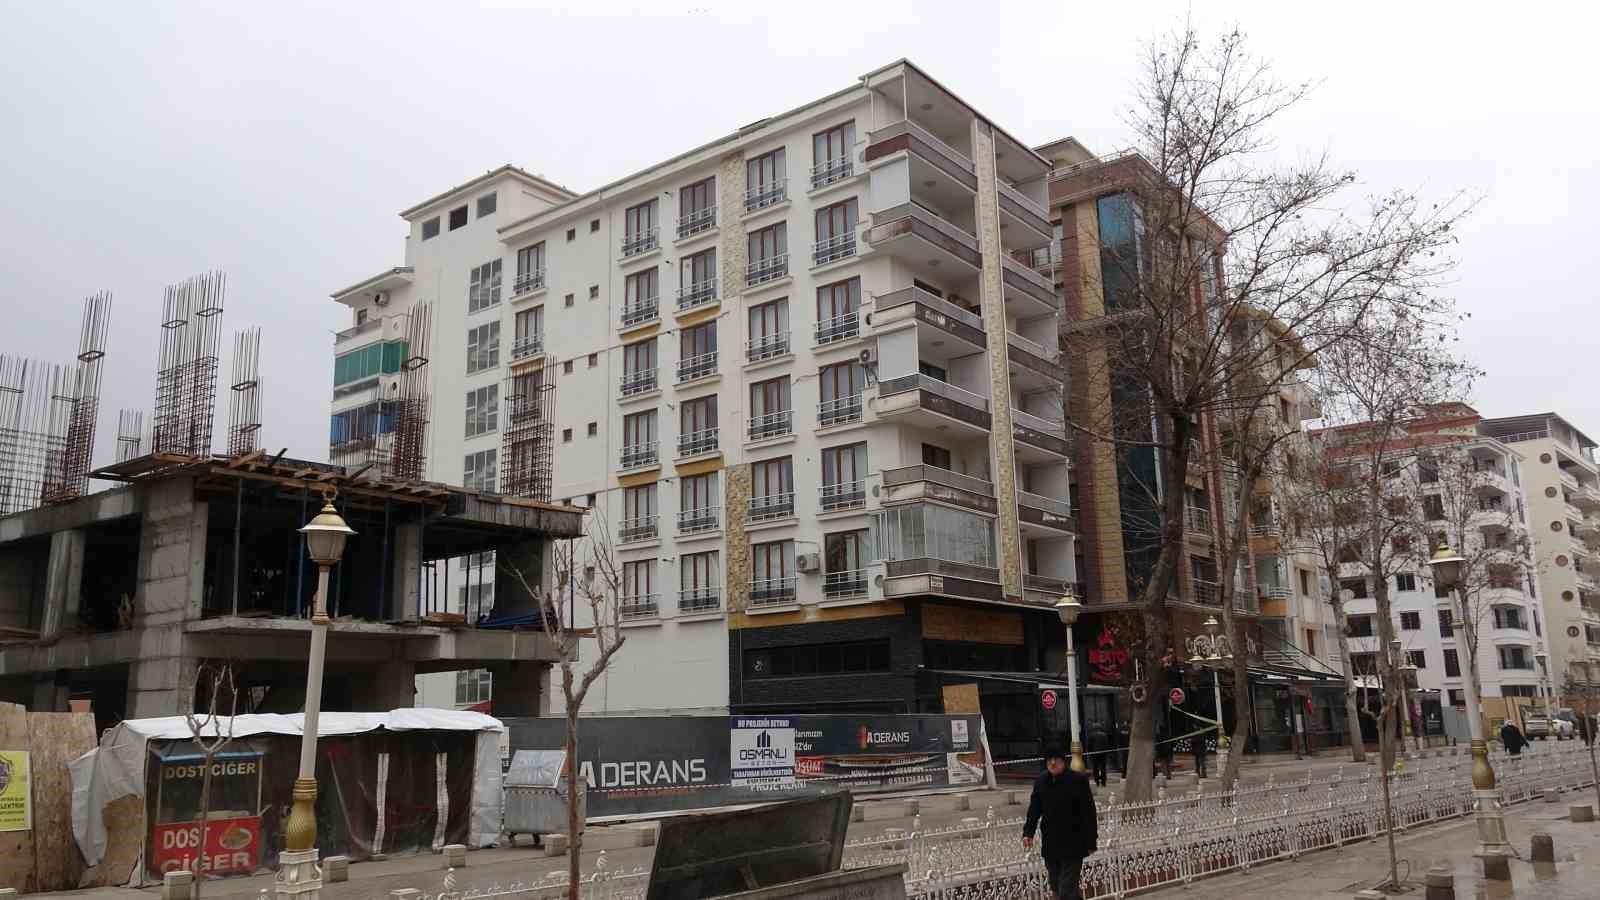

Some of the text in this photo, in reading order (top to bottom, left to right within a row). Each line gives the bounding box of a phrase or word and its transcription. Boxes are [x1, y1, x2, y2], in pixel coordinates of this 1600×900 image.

[867, 731, 910, 743] ADERANS
[739, 748, 787, 761] OSMANLI
[165, 764, 208, 779] DOST
[579, 758, 707, 788] ADERANS
[163, 826, 211, 849] DOST
